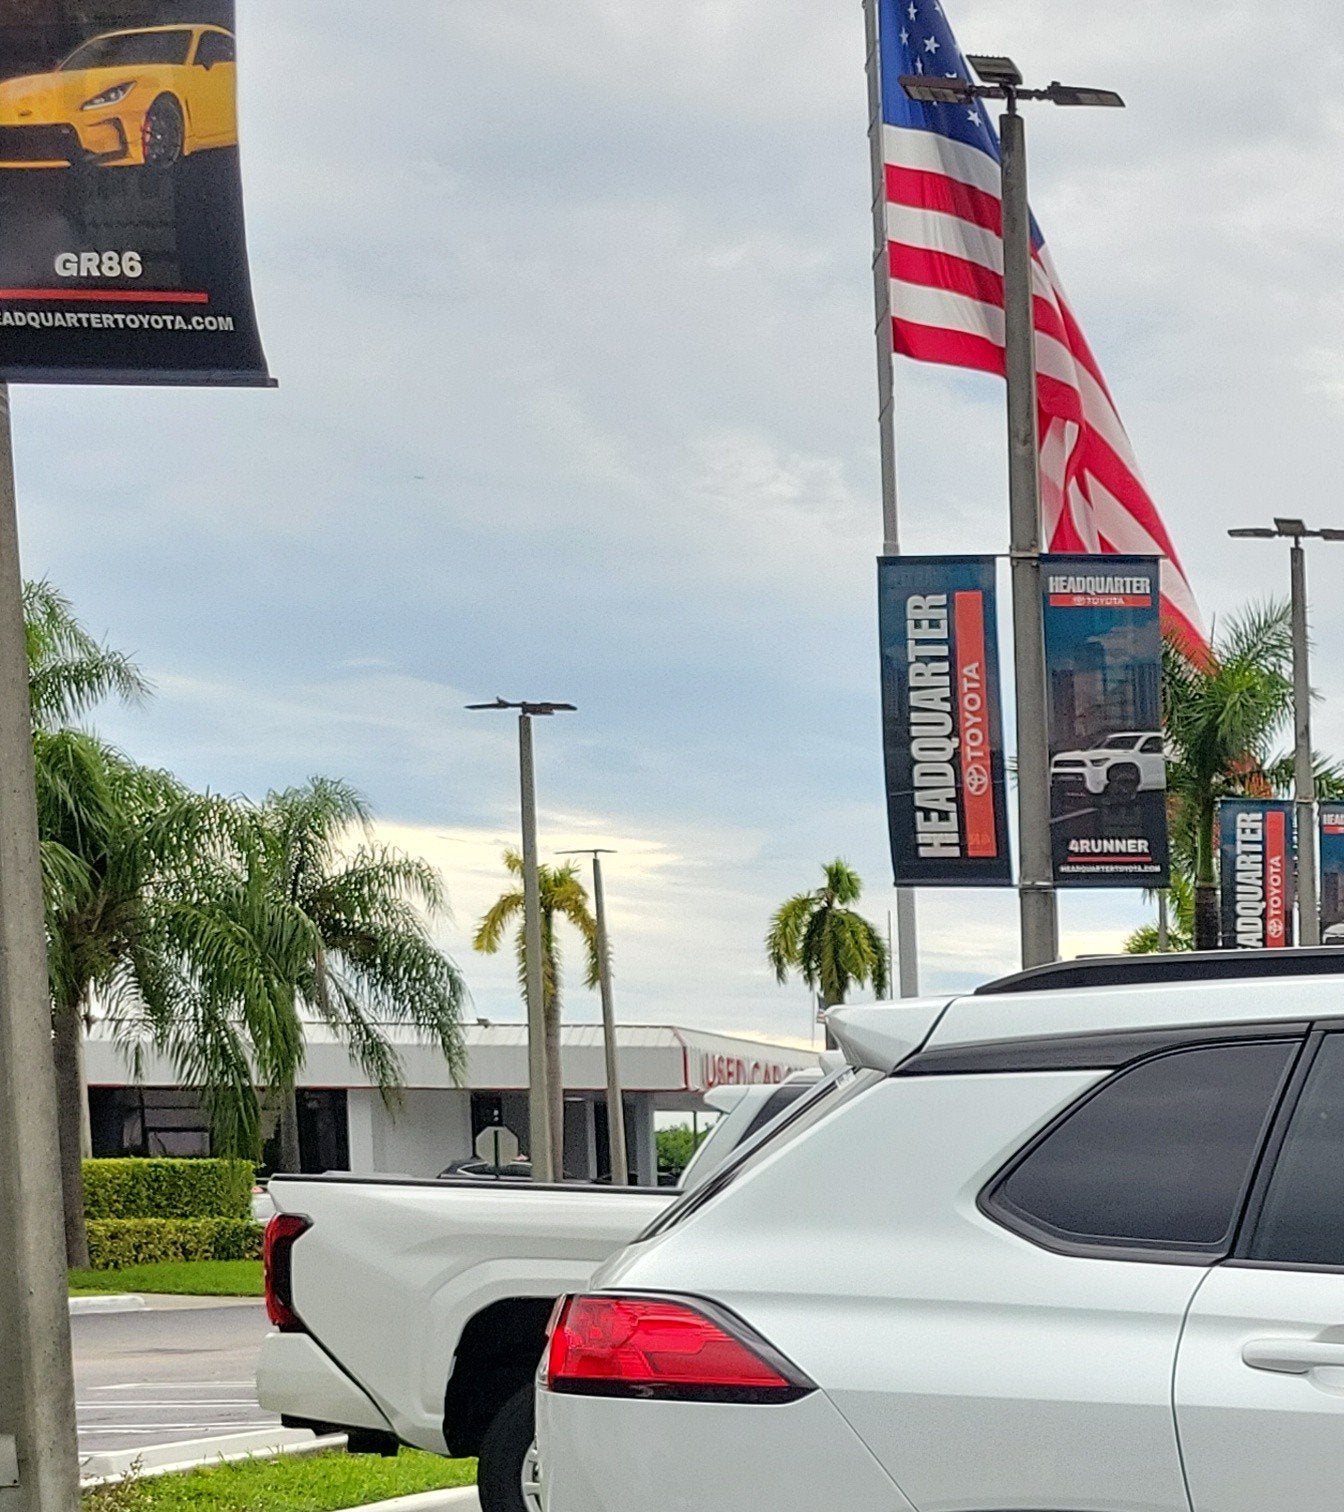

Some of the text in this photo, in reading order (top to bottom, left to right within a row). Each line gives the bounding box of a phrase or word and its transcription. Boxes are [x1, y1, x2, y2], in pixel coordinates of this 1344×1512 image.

[54, 250, 143, 278] GR86
[1049, 576, 1150, 595] HEADQUARTER
[1087, 597, 1125, 605] TOYOTA
[906, 593, 961, 858] HEADQUARTER
[962, 662, 985, 761] TOYOTA
[1068, 838, 1150, 853] 4RUNNER
[1236, 811, 1266, 948] ADQUARTER
[1270, 855, 1282, 916] TOYOTA
[705, 1053, 746, 1087] USED
